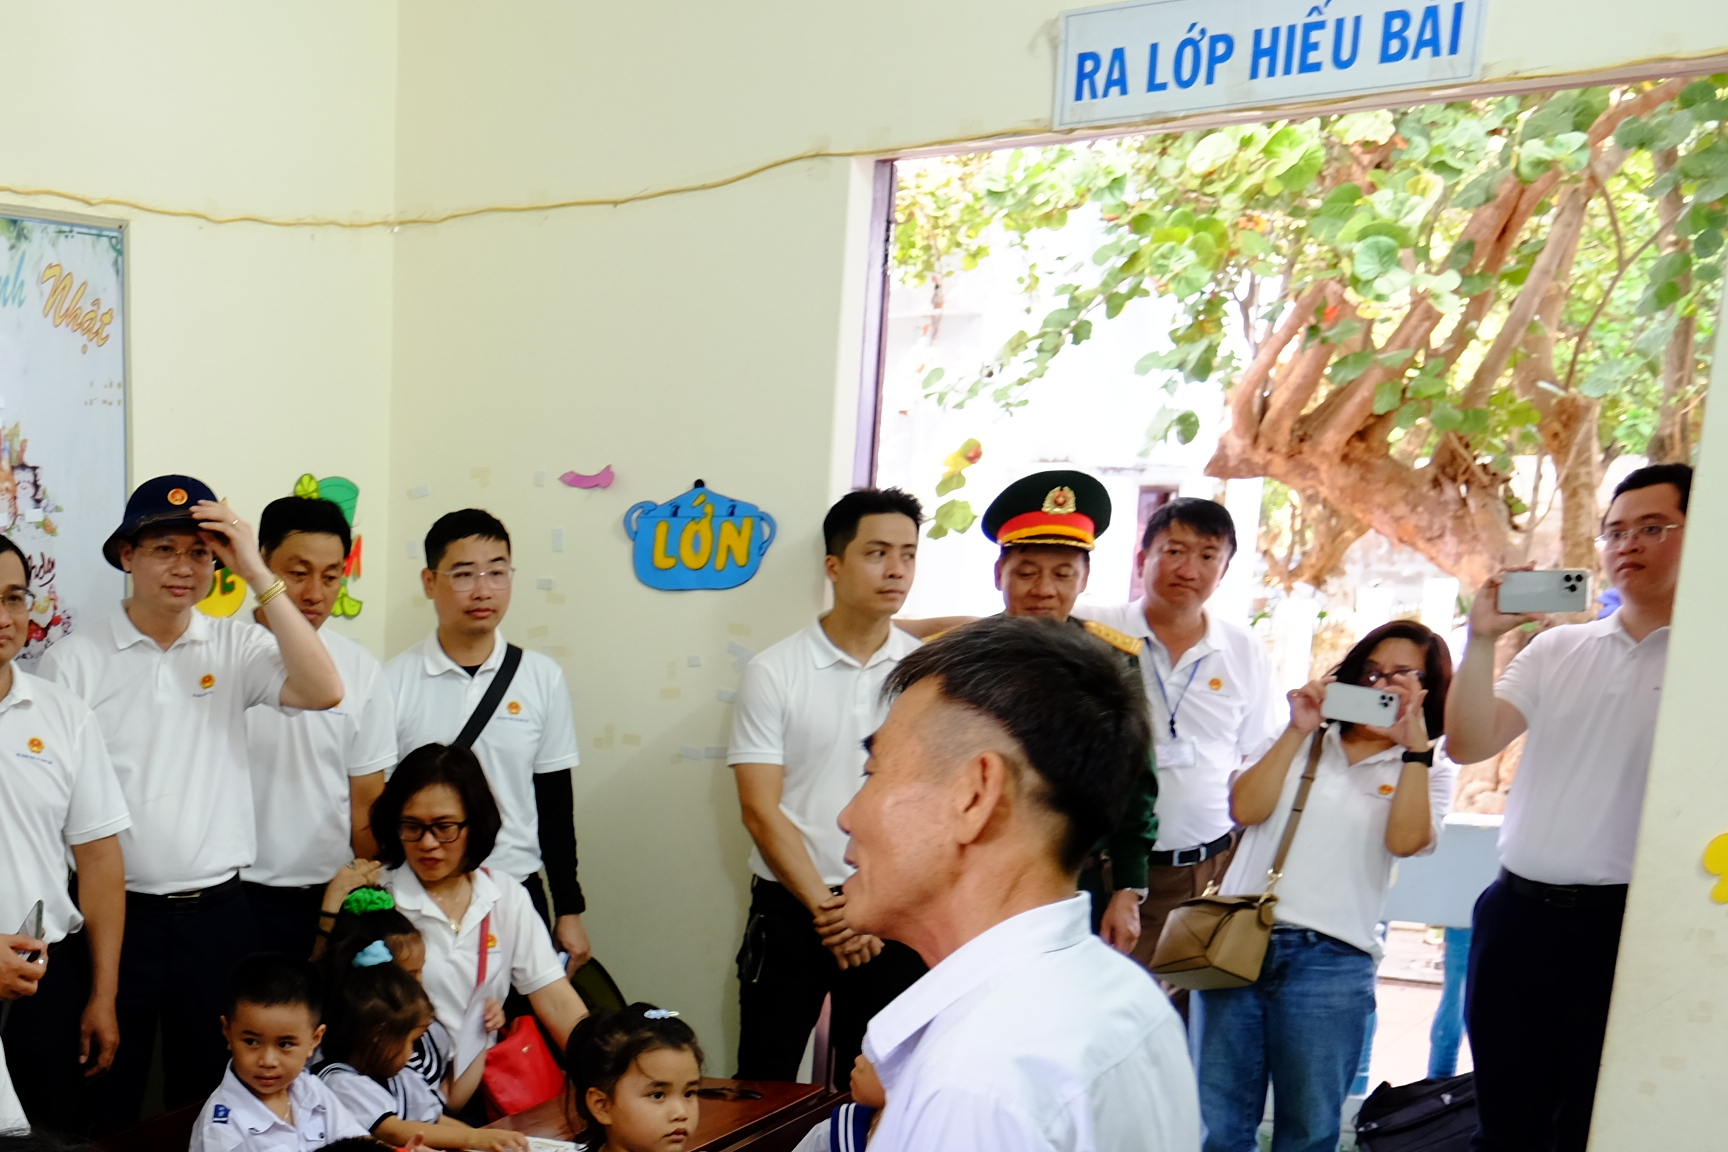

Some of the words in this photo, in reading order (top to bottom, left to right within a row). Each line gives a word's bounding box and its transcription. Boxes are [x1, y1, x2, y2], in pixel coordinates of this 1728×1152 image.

[1074, 46, 1129, 102] RA
[1146, 21, 1235, 93] LỚP
[40, 263, 115, 354] Nhật
[652, 493, 754, 571] LỚN
